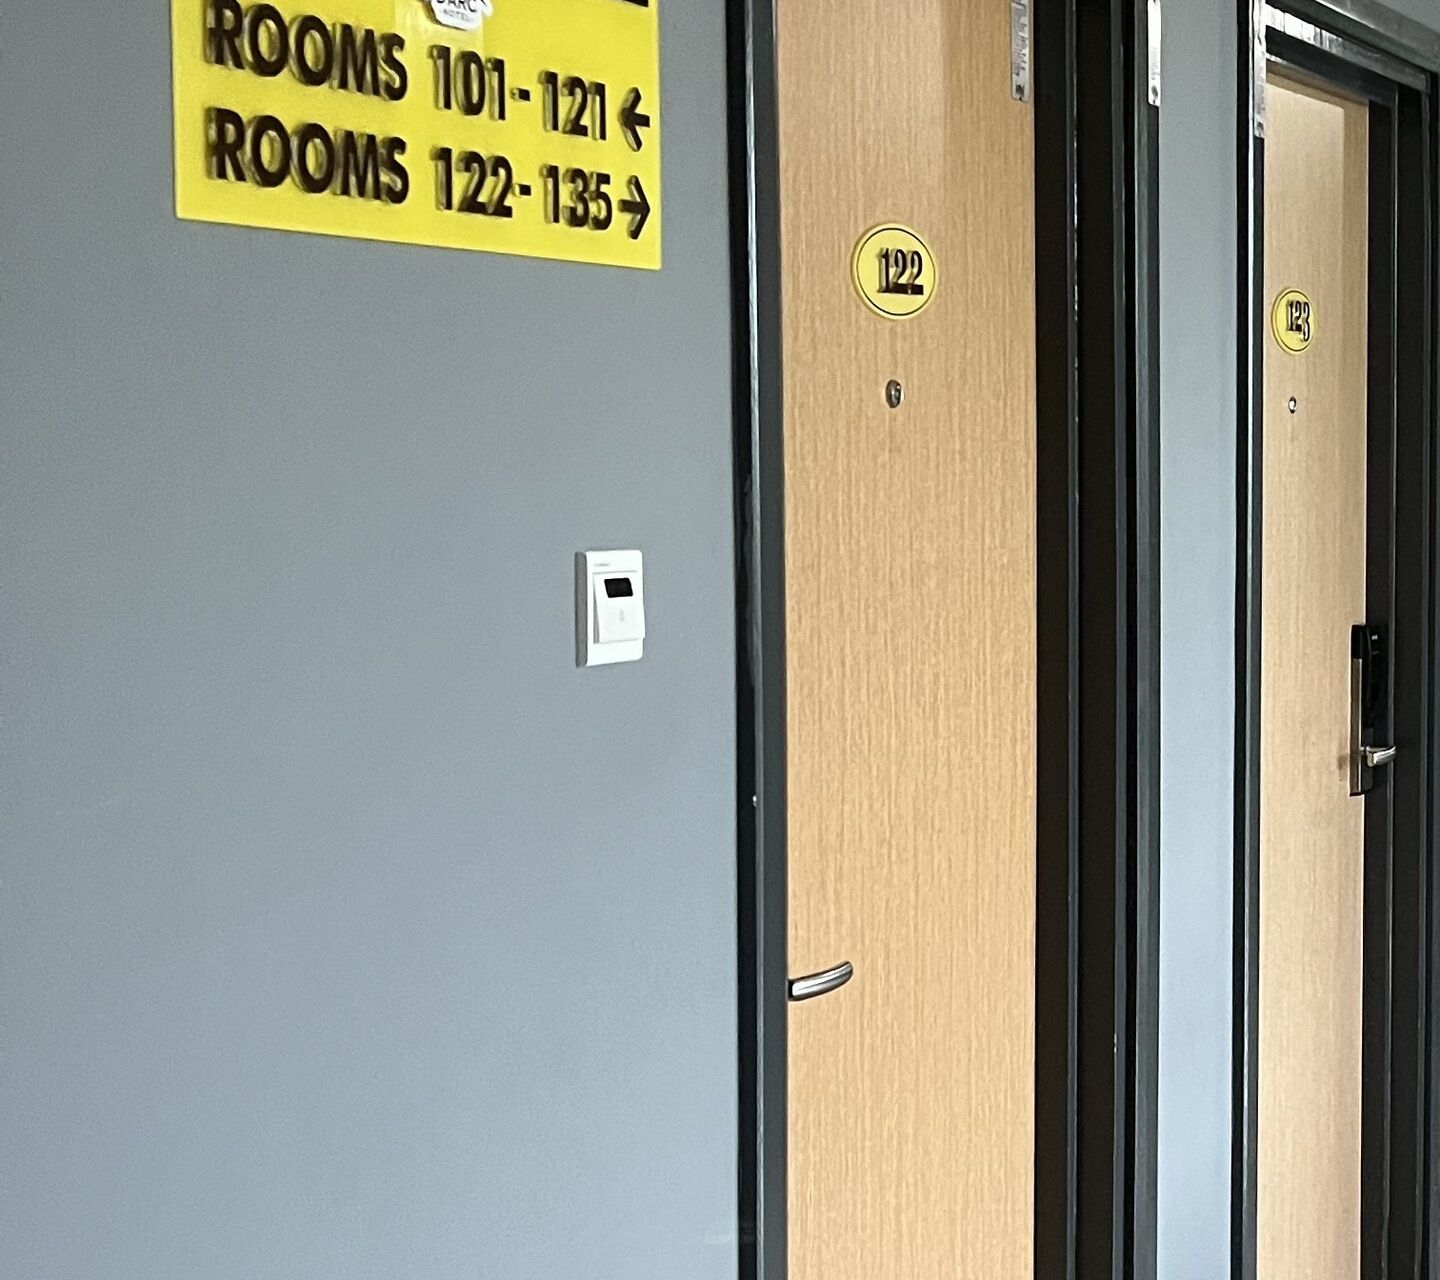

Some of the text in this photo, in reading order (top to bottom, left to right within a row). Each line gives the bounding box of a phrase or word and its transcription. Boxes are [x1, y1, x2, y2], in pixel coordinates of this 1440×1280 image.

[204, 107, 409, 204] ROOMS
[878, 247, 924, 296] 122
[1286, 299, 1311, 342] 123
